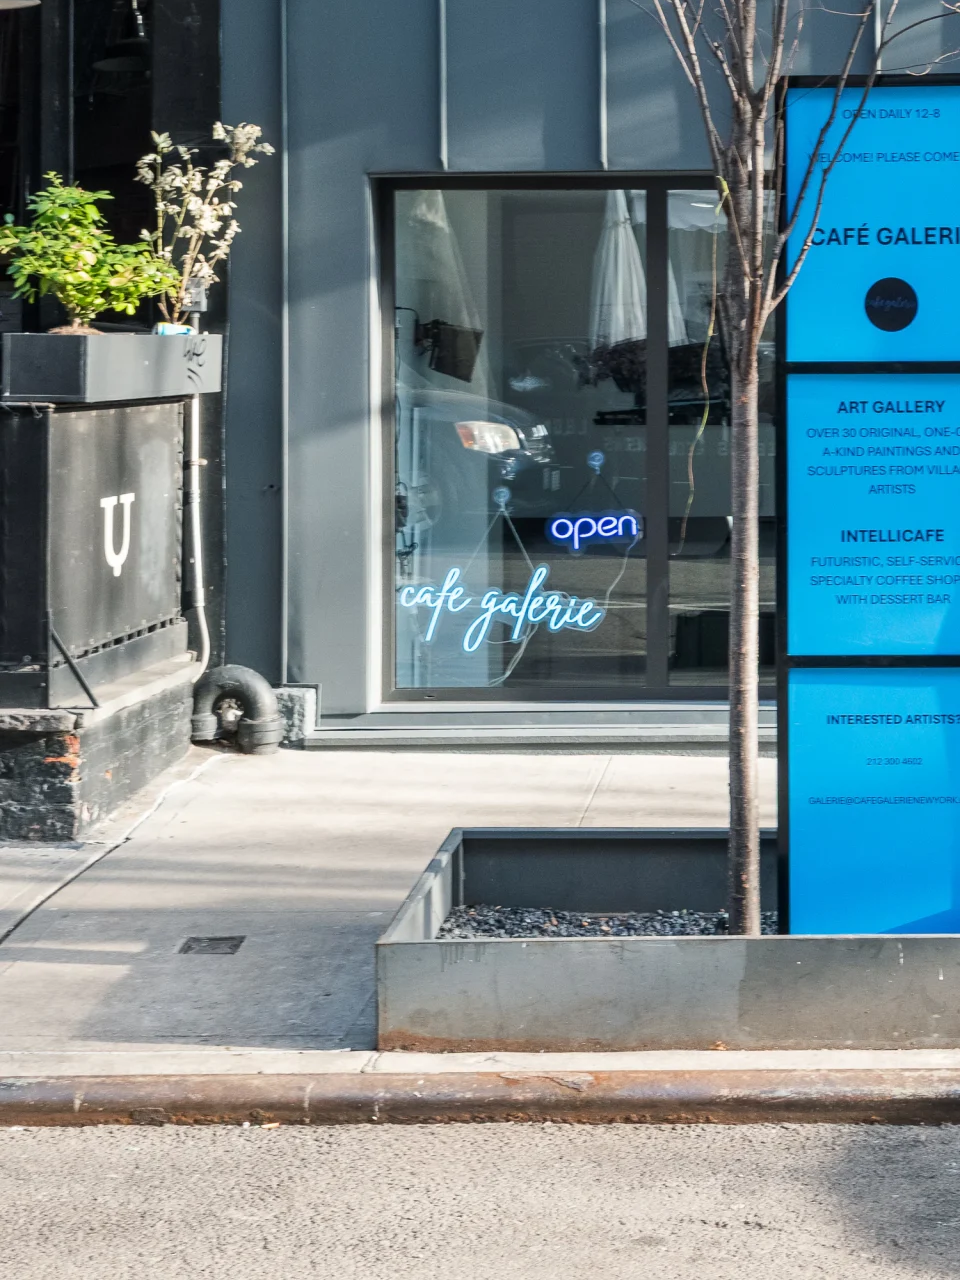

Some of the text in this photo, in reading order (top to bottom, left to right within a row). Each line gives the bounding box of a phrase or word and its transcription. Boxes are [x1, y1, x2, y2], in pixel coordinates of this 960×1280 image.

[878, 108, 913, 119] DAILY
[915, 108, 941, 119] 12-8
[876, 151, 921, 163] PLEASE
[923, 151, 960, 162] COME
[811, 222, 870, 246] CAFÉ
[836, 400, 946, 414] ART GALLERY
[806, 427, 840, 439] OVER
[842, 427, 857, 439] 30
[859, 427, 922, 439] ORIGINAL,
[822, 445, 960, 457] A-KIND PAINTINGS AND
[807, 465, 887, 477] SCULPTURES
[889, 465, 924, 476] FROM
[868, 483, 917, 495] ARTISTS
[551, 515, 638, 550] open
[841, 528, 945, 543] INTELLICAFE
[811, 556, 884, 568] FUTURISTIC,
[810, 575, 874, 587] SPECIALTY
[876, 575, 923, 586] COFFEE
[835, 593, 951, 605] WITH DESSERT BAR
[400, 566, 602, 653] cafe galerie
[827, 714, 903, 725] INTERESTED
